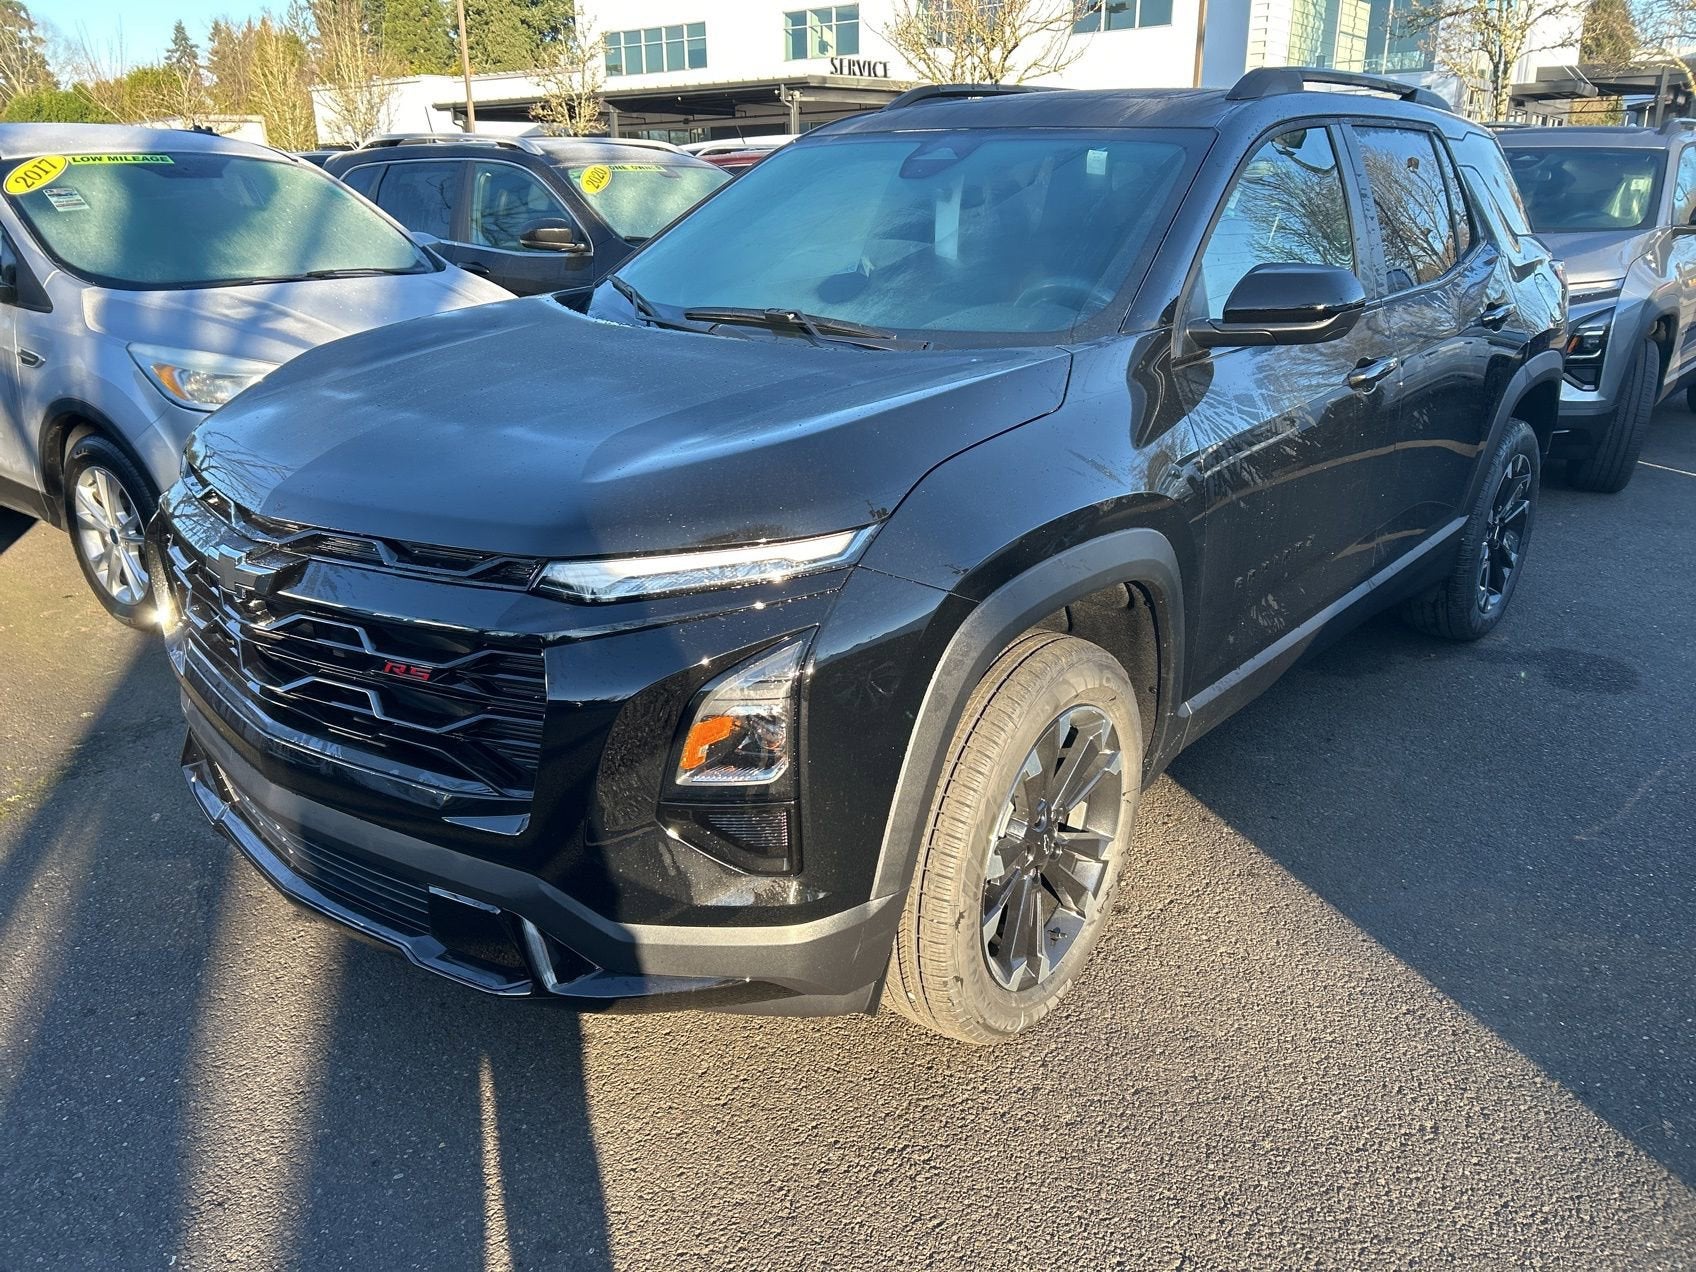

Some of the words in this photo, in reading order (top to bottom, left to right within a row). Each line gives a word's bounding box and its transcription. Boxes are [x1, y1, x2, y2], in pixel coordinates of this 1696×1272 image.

[830, 57, 890, 78] SERVICE
[108, 155, 170, 163] MILEAGE
[15, 159, 58, 188] 2017
[586, 167, 607, 189] 2020
[384, 661, 432, 681] RS
